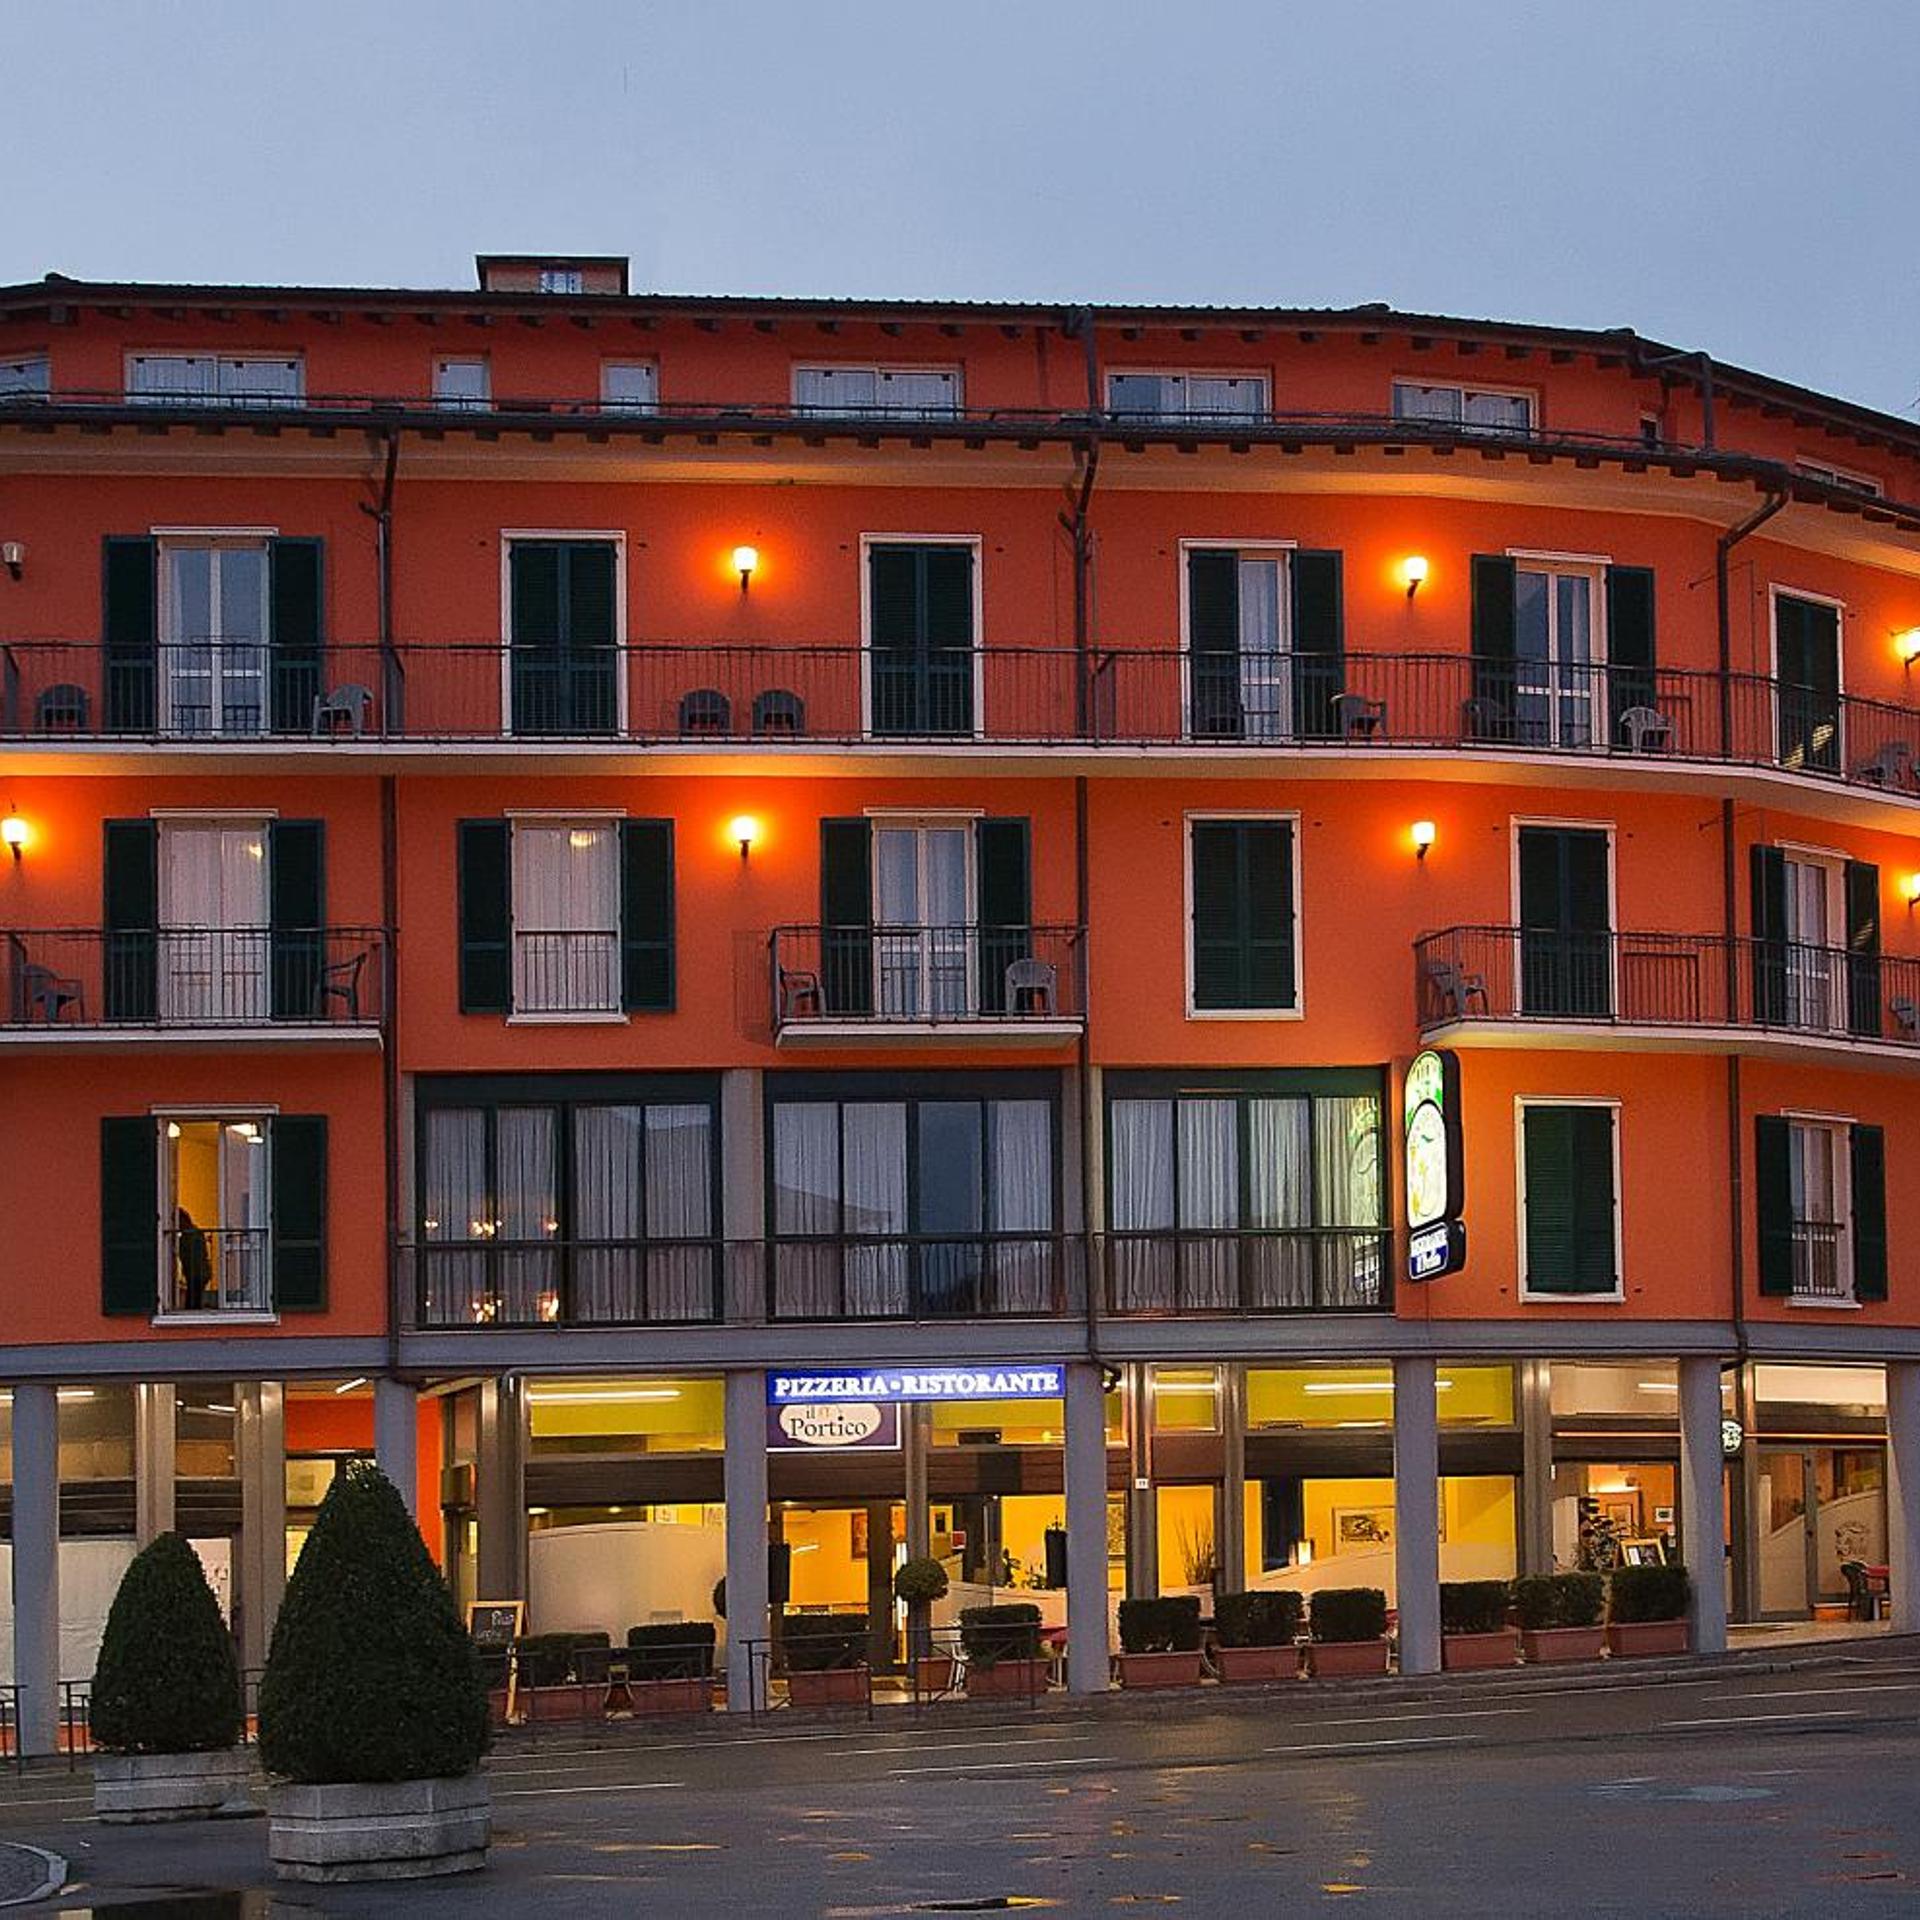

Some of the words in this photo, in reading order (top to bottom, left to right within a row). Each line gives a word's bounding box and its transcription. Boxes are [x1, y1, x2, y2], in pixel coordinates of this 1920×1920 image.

[775, 1377, 889, 1397] PIZZERIA
[902, 1373, 1058, 1394] RISTORANTE
[789, 1416, 868, 1437] Portico
